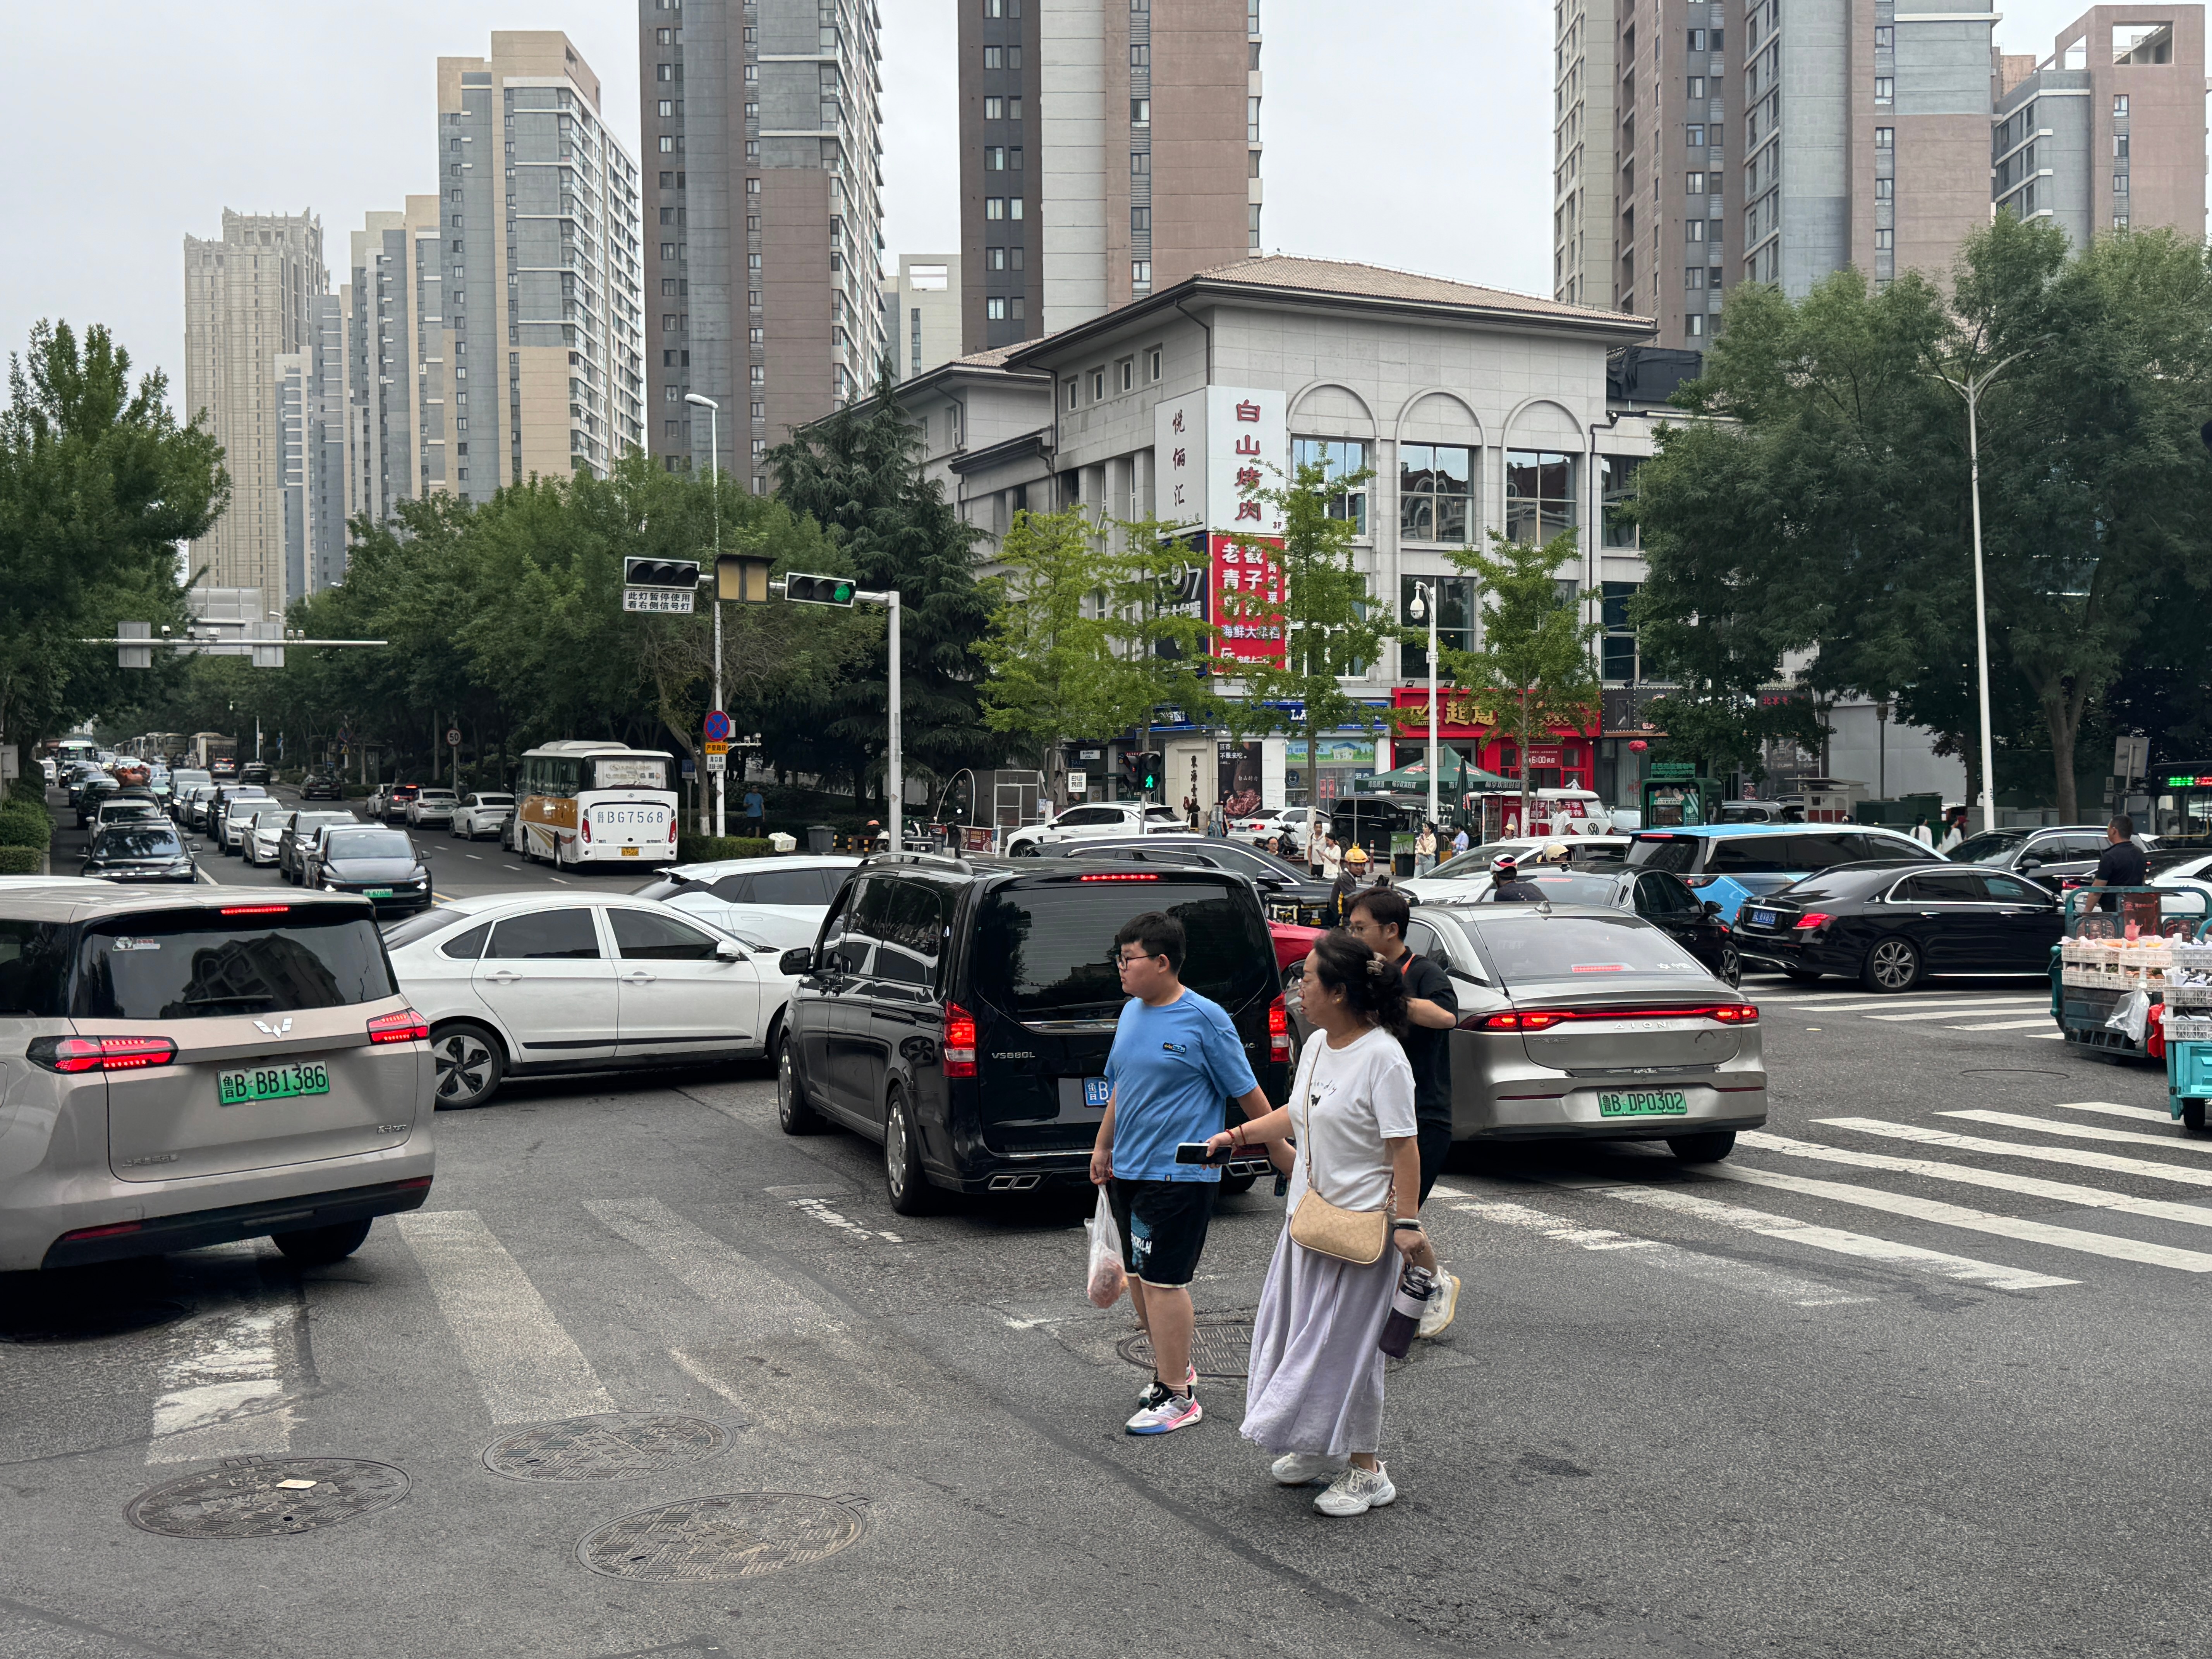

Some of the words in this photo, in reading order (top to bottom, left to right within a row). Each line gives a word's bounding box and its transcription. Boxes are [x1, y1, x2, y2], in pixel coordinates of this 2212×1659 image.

[1235, 399, 1263, 522] 白山烤肉
[628, 592, 690, 602] 此灯暂停使用
[627, 601, 690, 610] 看右侧信号灯
[450, 733, 459, 741] 50
[598, 811, 663, 823] 鲁BG7568
